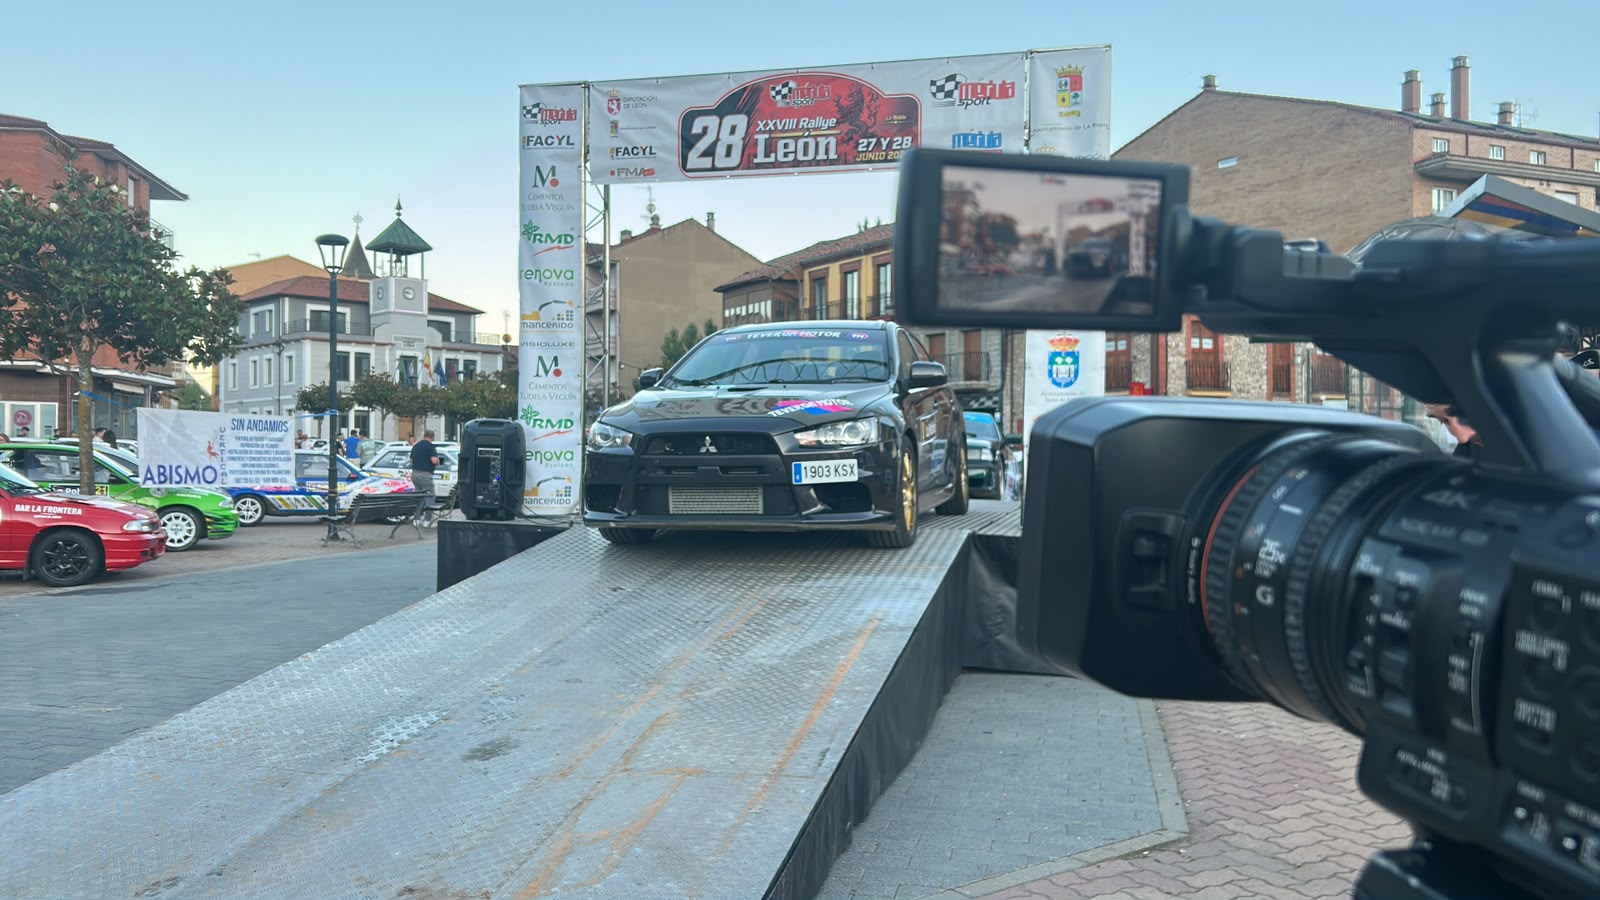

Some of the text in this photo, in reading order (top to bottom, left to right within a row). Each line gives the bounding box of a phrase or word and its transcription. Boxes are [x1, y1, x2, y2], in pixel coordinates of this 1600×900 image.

[792, 98, 816, 109] sport
[957, 96, 991, 110] sport
[540, 119, 562, 127] sport
[756, 117, 837, 132] XXVIII Rallye
[526, 135, 575, 147] FACYL
[686, 114, 749, 170] 28
[753, 132, 838, 163] León
[858, 136, 913, 151] 27 Y 28
[615, 145, 657, 157] FACYL
[856, 151, 885, 162] JUNIO
[532, 232, 575, 245] RMD
[799, 330, 842, 338] MOTOR
[231, 418, 289, 433] SIN ANDAMIOS
[532, 418, 575, 429] RMD
[525, 450, 574, 464] enova
[142, 464, 218, 485] ABISMO
[803, 463, 856, 478] 1903 KSX
[14, 503, 29, 512] BAR
[31, 504, 42, 513] LA
[42, 504, 83, 516] FRONTERA
[1256, 585, 1274, 606] G
